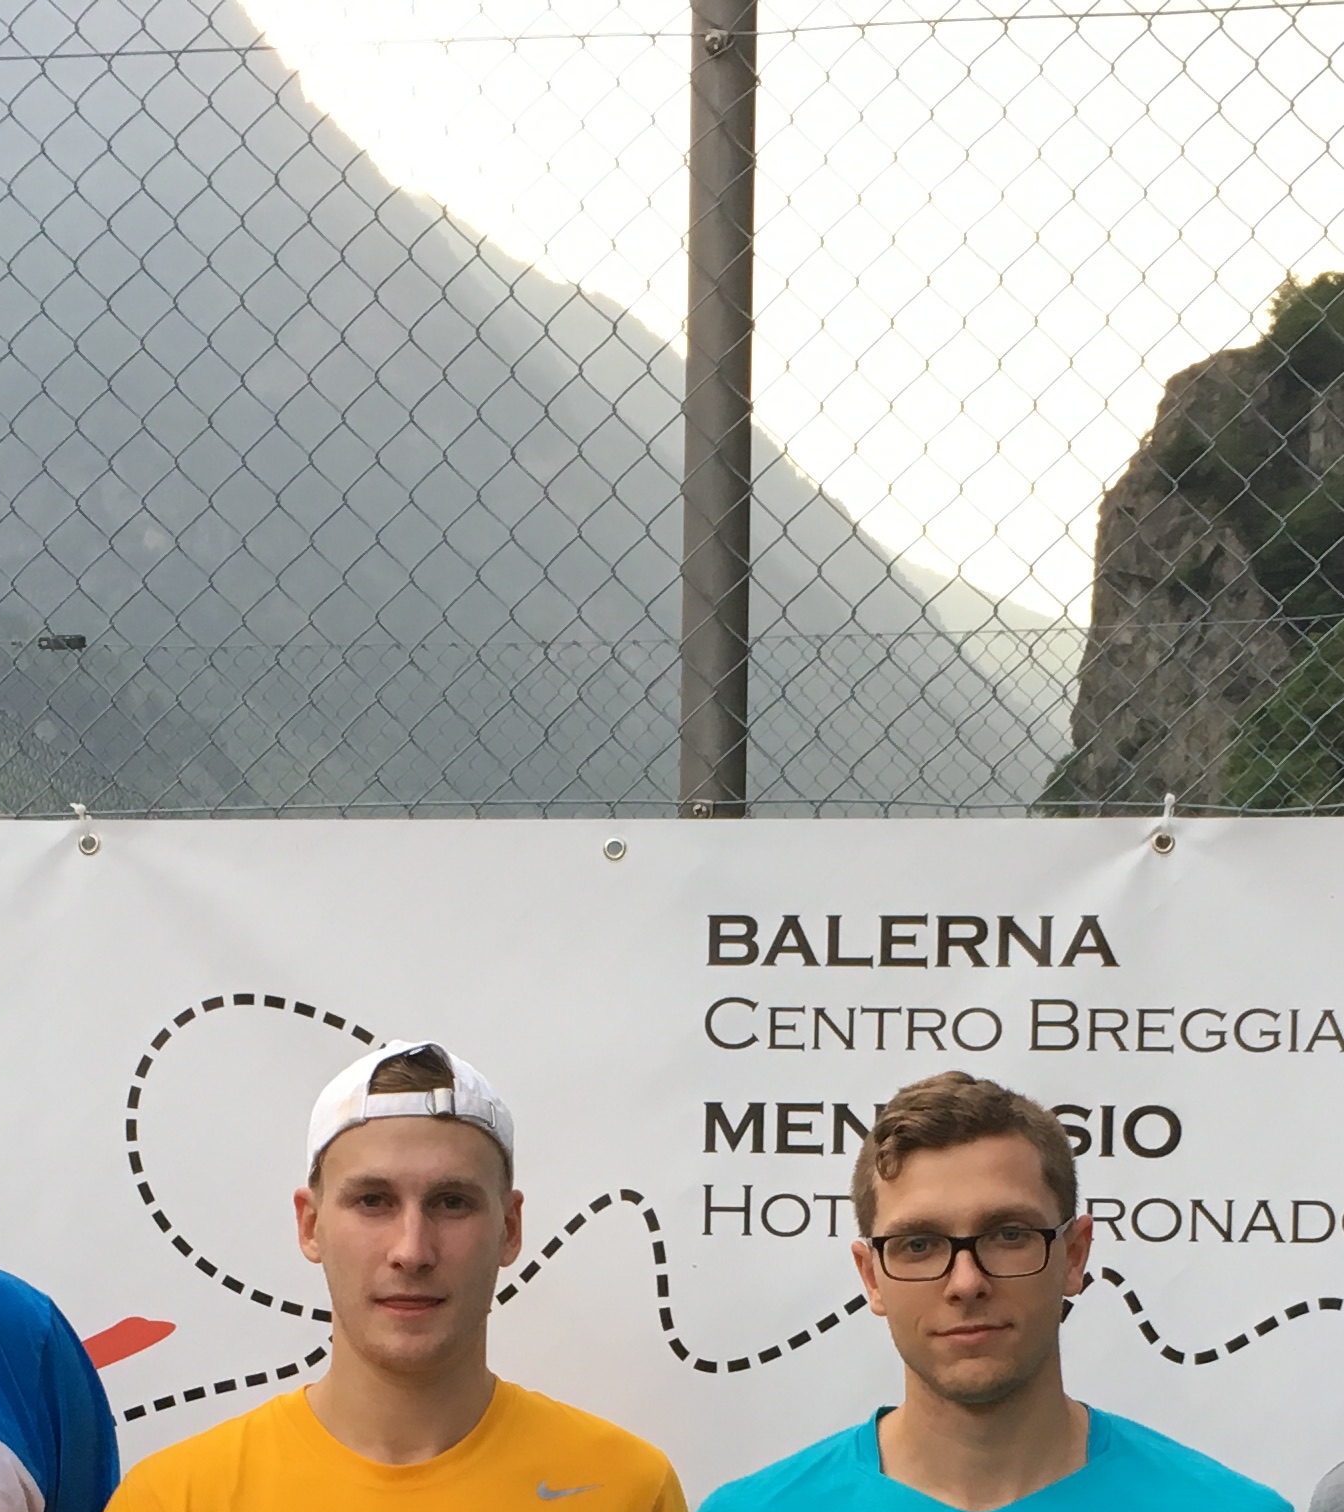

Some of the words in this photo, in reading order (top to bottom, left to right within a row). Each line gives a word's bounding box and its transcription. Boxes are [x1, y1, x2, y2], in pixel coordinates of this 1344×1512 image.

[706, 914, 1120, 968] BALERNA
[704, 996, 1003, 1052] CENTRO
[702, 1101, 1183, 1159] MENSIO
[702, 1184, 854, 1238] HOT
